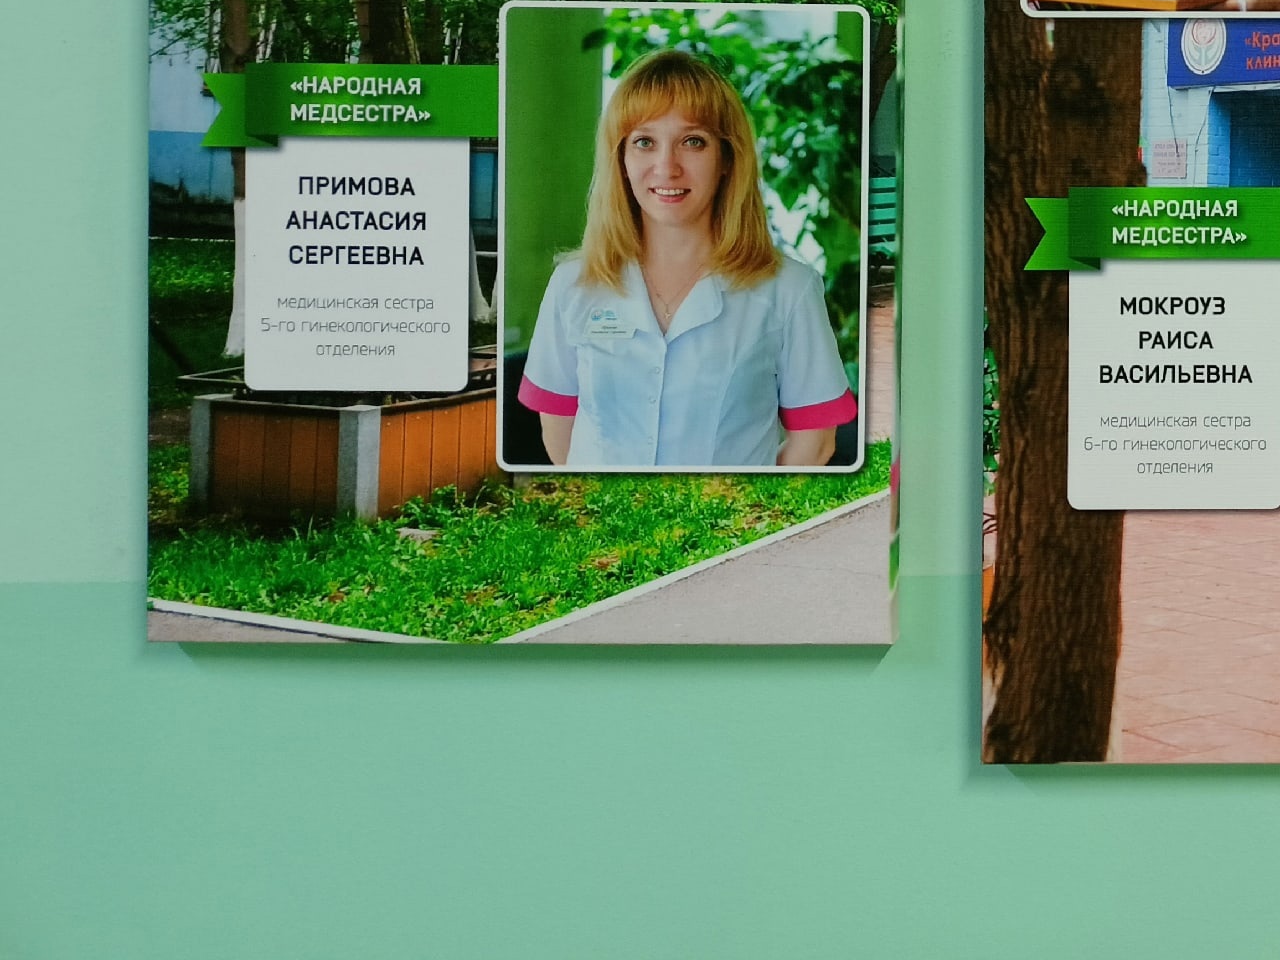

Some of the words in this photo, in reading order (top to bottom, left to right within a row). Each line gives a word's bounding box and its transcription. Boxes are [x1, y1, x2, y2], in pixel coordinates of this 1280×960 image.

[290, 76, 421, 97] «НАРОДНАЯ
[290, 104, 431, 124] МЕДСЕСТРА»
[298, 176, 415, 196] ПРИМОВА
[1112, 199, 1238, 219] «НАРОДНАЯ
[286, 211, 426, 230] АНАСТАСИЯ
[1112, 227, 1247, 246] МЕДСЕСТРА»
[289, 245, 424, 265] СЕРГЕЕВНА
[277, 296, 379, 311] медицинская
[384, 298, 434, 312] сестра
[1120, 296, 1225, 315] МОКРОУЗ
[261, 317, 295, 332] 5-го
[301, 320, 450, 334] гинекологического
[1138, 331, 1214, 349] РАИСА
[316, 344, 395, 357] отделения
[1099, 365, 1253, 384] ВАСИЛЬЕВНА
[1099, 415, 1197, 428] медицинская
[1203, 415, 1251, 429] сестра
[1083, 437, 1118, 451] 6-го
[1123, 439, 1267, 452] гинекологического
[1137, 461, 1213, 474] отделения
